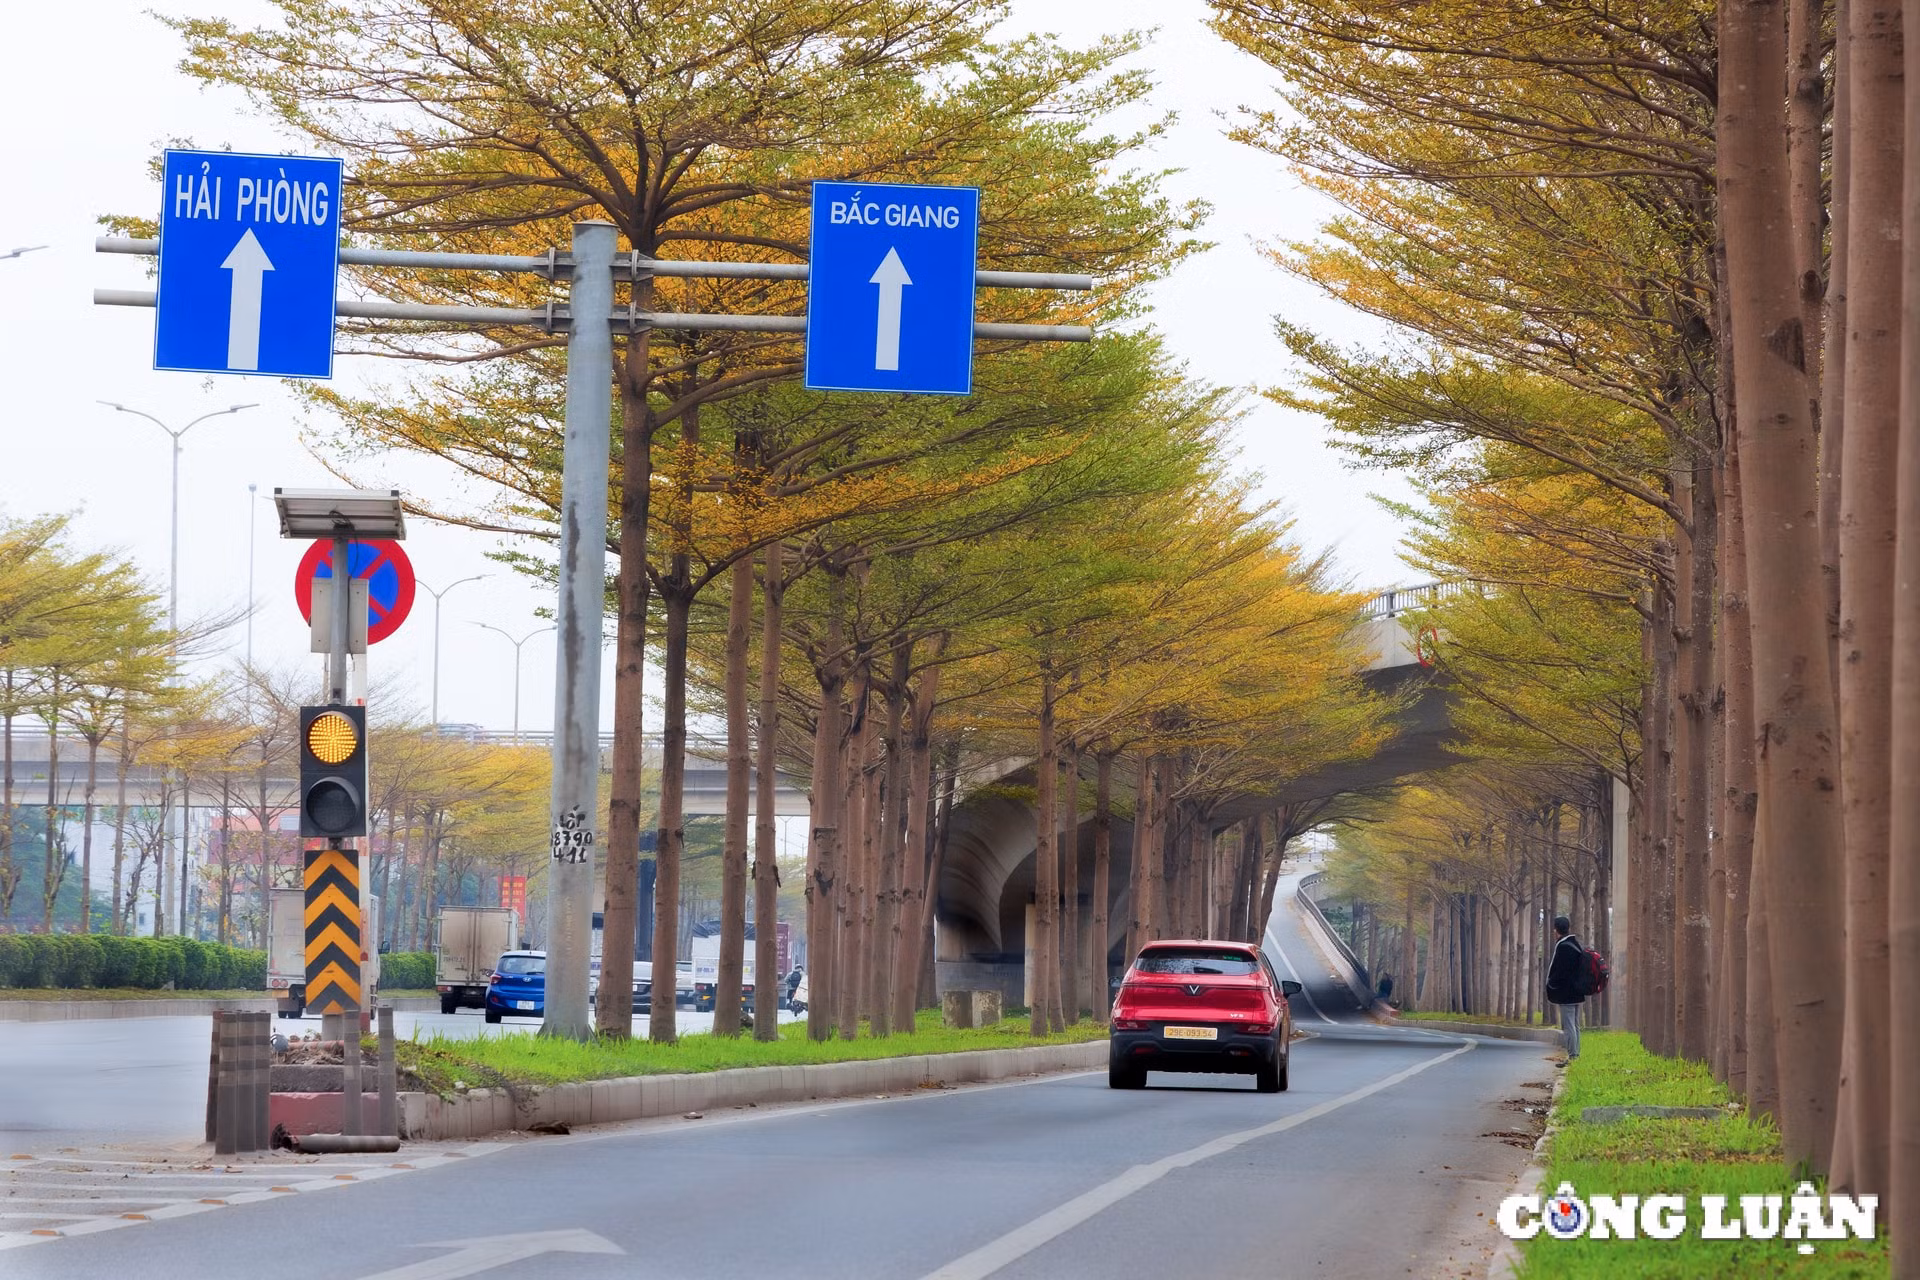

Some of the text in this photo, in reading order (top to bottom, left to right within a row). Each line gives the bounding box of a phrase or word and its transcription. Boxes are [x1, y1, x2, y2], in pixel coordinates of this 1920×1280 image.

[175, 161, 329, 226] HẢI PHÒNG
[830, 190, 960, 229] BẮC GIANG
